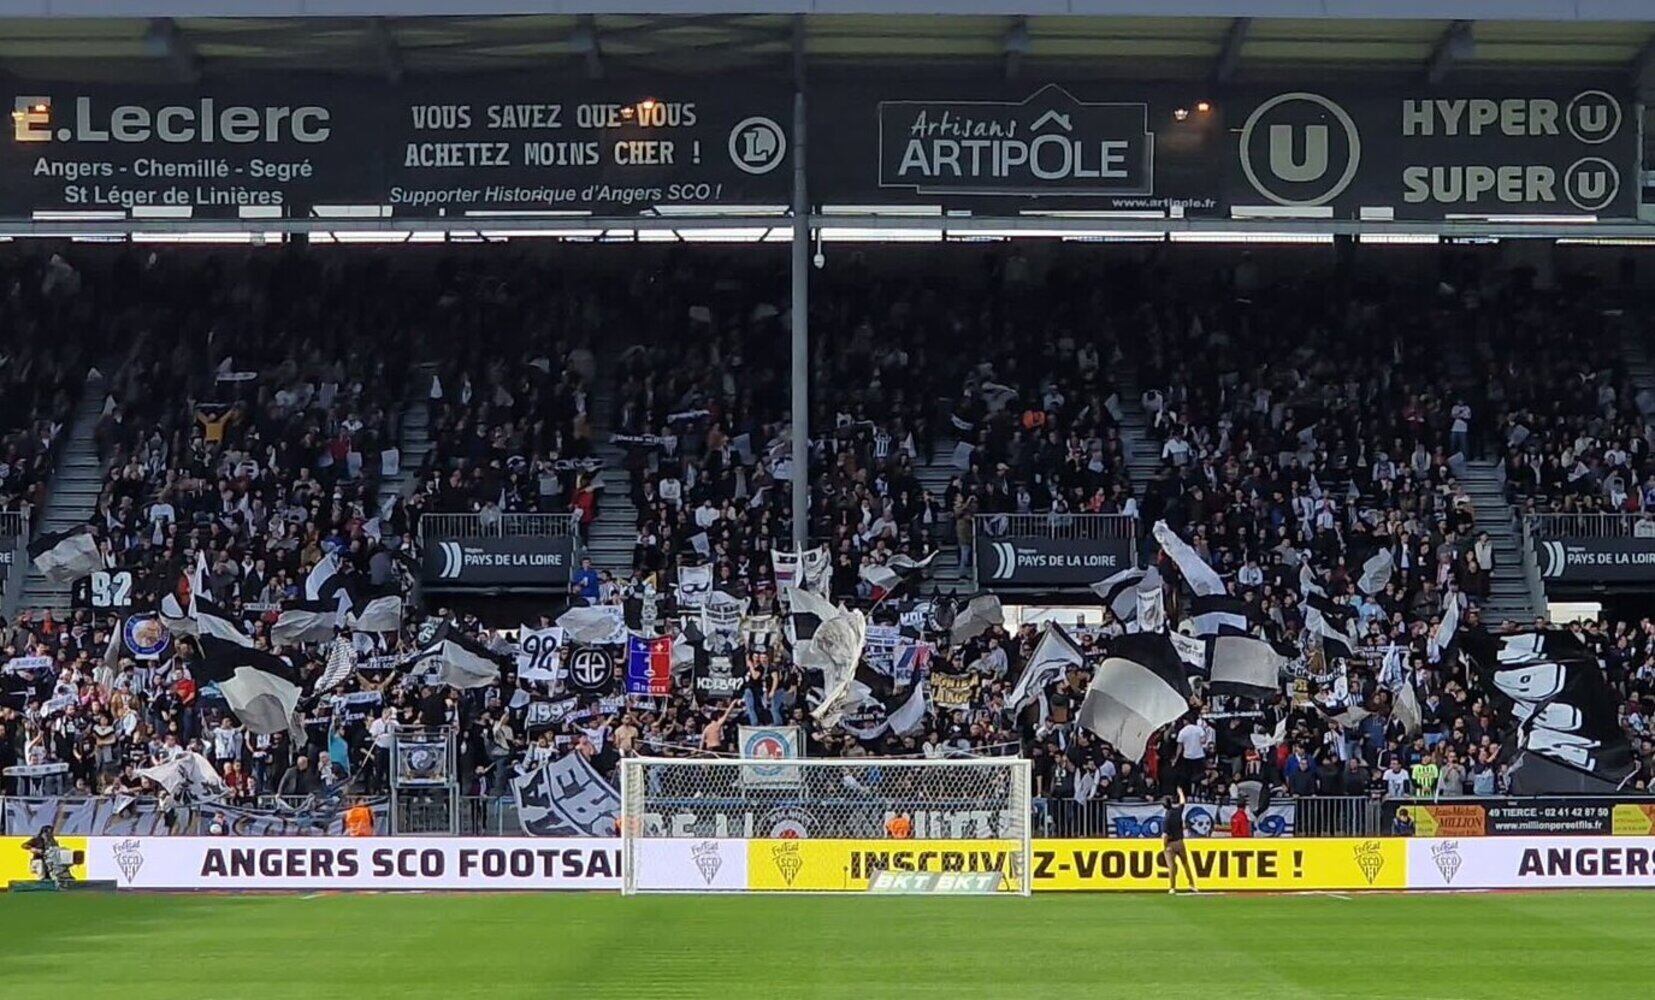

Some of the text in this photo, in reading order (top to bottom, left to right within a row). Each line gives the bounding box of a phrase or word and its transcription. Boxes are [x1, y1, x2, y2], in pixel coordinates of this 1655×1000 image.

[14, 96, 331, 142] E.Leclerc
[412, 102, 697, 129] VOUS SAVEZ QUE VOUS
[910, 110, 1016, 138] Artisans
[1403, 99, 1559, 136] HYPER
[404, 141, 701, 167] ACHETEZ MOINS CHER !
[1269, 124, 1328, 182] U
[33, 157, 114, 180] Angers
[134, 158, 229, 178] Chemillé
[249, 158, 313, 181] Segré
[64, 186, 284, 207] St Léger de Linières
[390, 186, 481, 206] Supporter
[485, 186, 577, 205] Historique
[581, 184, 662, 204] d'Angers
[668, 184, 711, 200] SCO
[1403, 166, 1555, 202] SUPER
[464, 554, 562, 566] PAYS DE LA LOIRE
[1017, 554, 1117, 566] PAYS DE LA LOIRE
[1567, 552, 1595, 564] PAYS
[1597, 552, 1612, 564] DE
[1615, 552, 1630, 564] LA
[91, 571, 132, 607] 92
[200, 848, 359, 877] ANGERS
[372, 848, 445, 877] SCO
[1190, 850, 1278, 878] VITE
[1292, 850, 1304, 878] !
[1518, 848, 1655, 876] ANGER
[875, 874, 991, 890] BKT BKT
